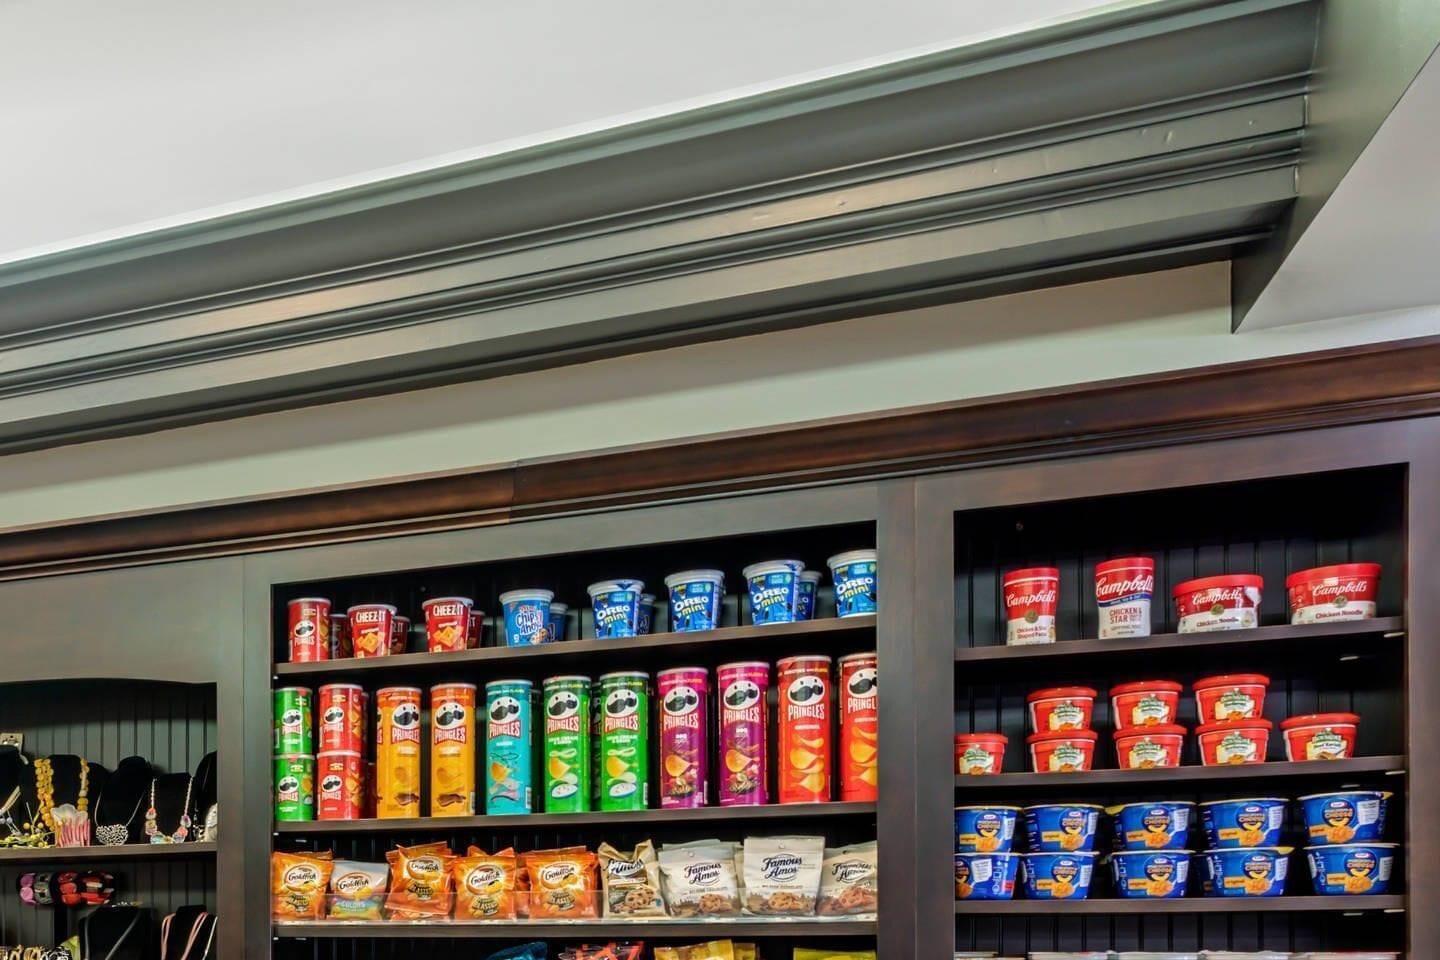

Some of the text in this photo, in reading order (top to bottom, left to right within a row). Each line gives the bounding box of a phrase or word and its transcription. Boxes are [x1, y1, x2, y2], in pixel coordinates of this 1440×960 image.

[837, 577, 874, 594] OREO
[844, 583, 870, 601] mini
[1096, 575, 1153, 597] Campbell's
[1312, 581, 1367, 595] Campbell's
[752, 586, 789, 604] OREO
[761, 594, 786, 607] mini
[1007, 590, 1055, 607] Campbell's
[1192, 588, 1242, 605] Campbell's
[674, 595, 709, 613] OREO
[682, 603, 705, 616] mini
[1110, 607, 1138, 616] CHICKEN
[596, 605, 630, 620] OREO
[604, 611, 626, 624] mini
[1111, 615, 1128, 624] STAR
[788, 703, 824, 720] PRINGLES
[848, 698, 876, 713] PRINGL
[605, 714, 638, 732] PRINGLES
[663, 713, 698, 731] PRINGLES
[724, 706, 759, 726] PRINGLES
[489, 722, 521, 738] PRINGLES
[547, 716, 579, 733] PRINGLES
[434, 729, 465, 743] PRINGLES
[684, 863, 721, 876] Famous
[761, 856, 802, 871] Famous
[470, 872, 501, 884] Goldfish
[544, 867, 575, 880] Goldfish
[763, 867, 797, 880] Amos
